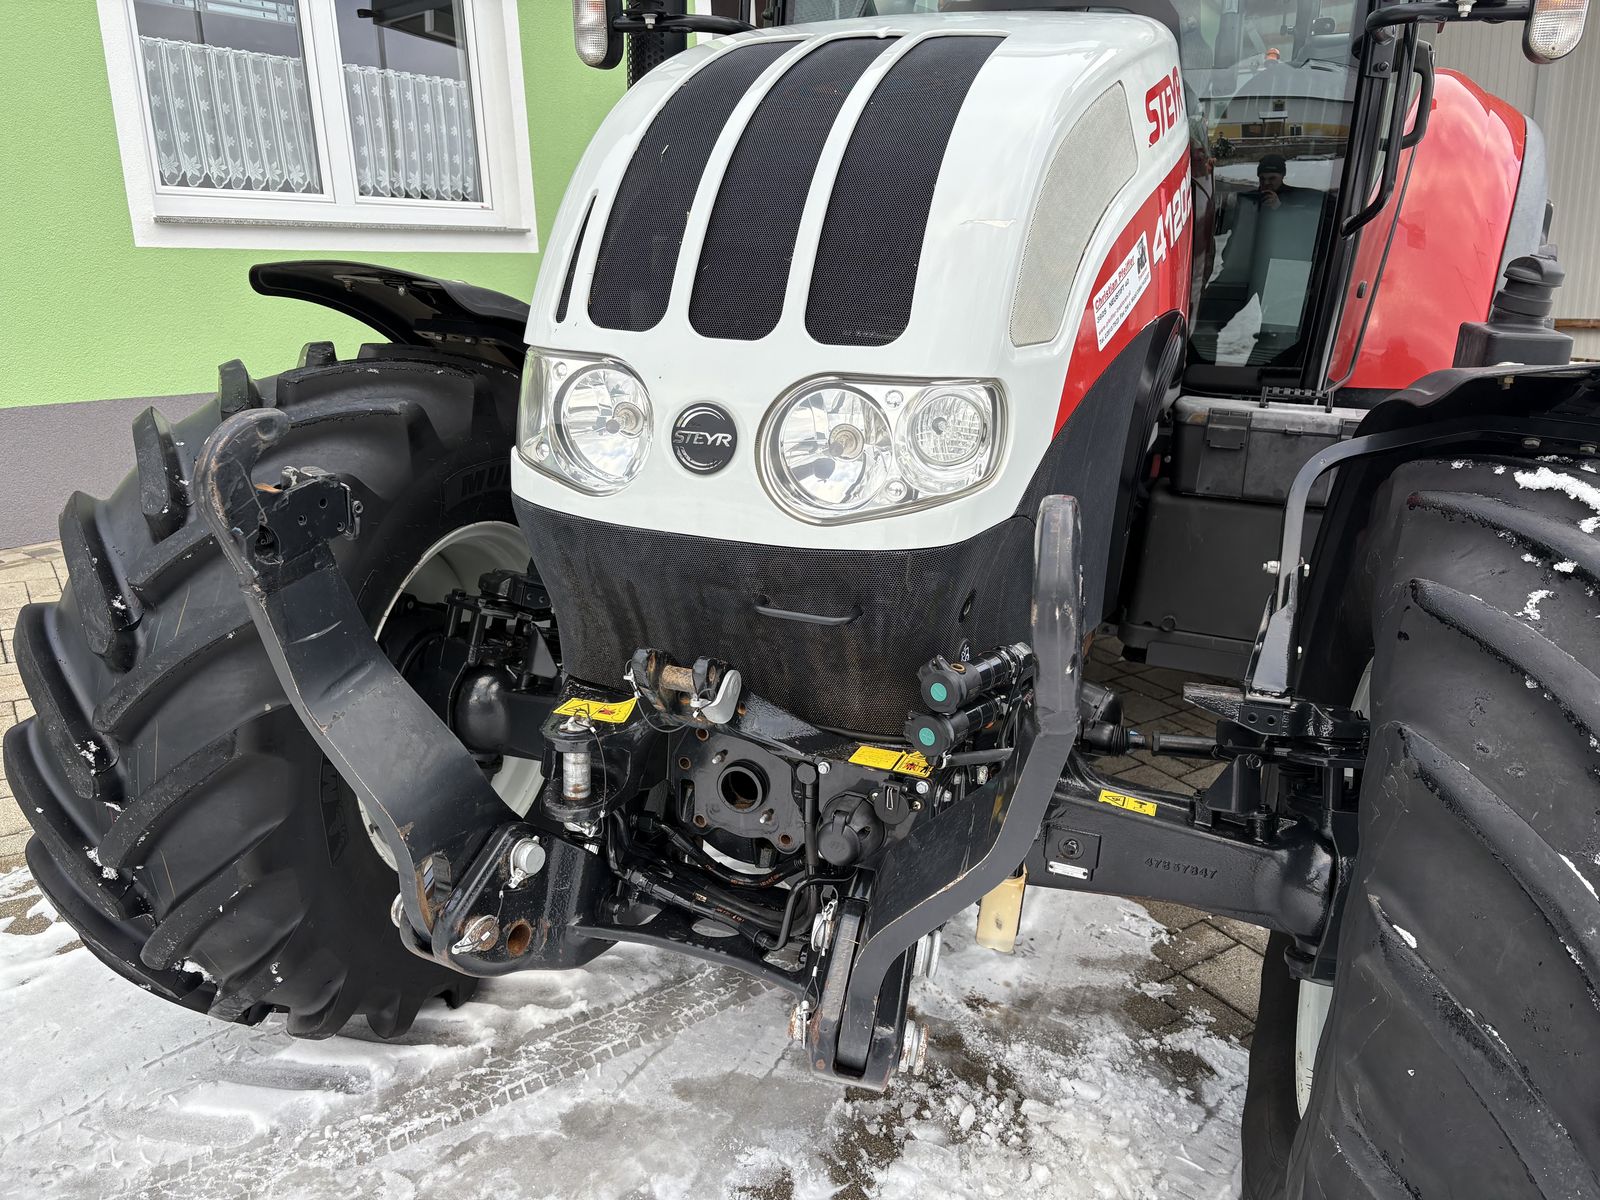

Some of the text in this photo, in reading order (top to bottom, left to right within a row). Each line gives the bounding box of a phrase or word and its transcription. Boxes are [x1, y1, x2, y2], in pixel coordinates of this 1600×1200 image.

[1145, 66, 1184, 147] STEYR
[1094, 255, 1135, 310] Christian Pfeiffer
[673, 430, 732, 447] STEYR
